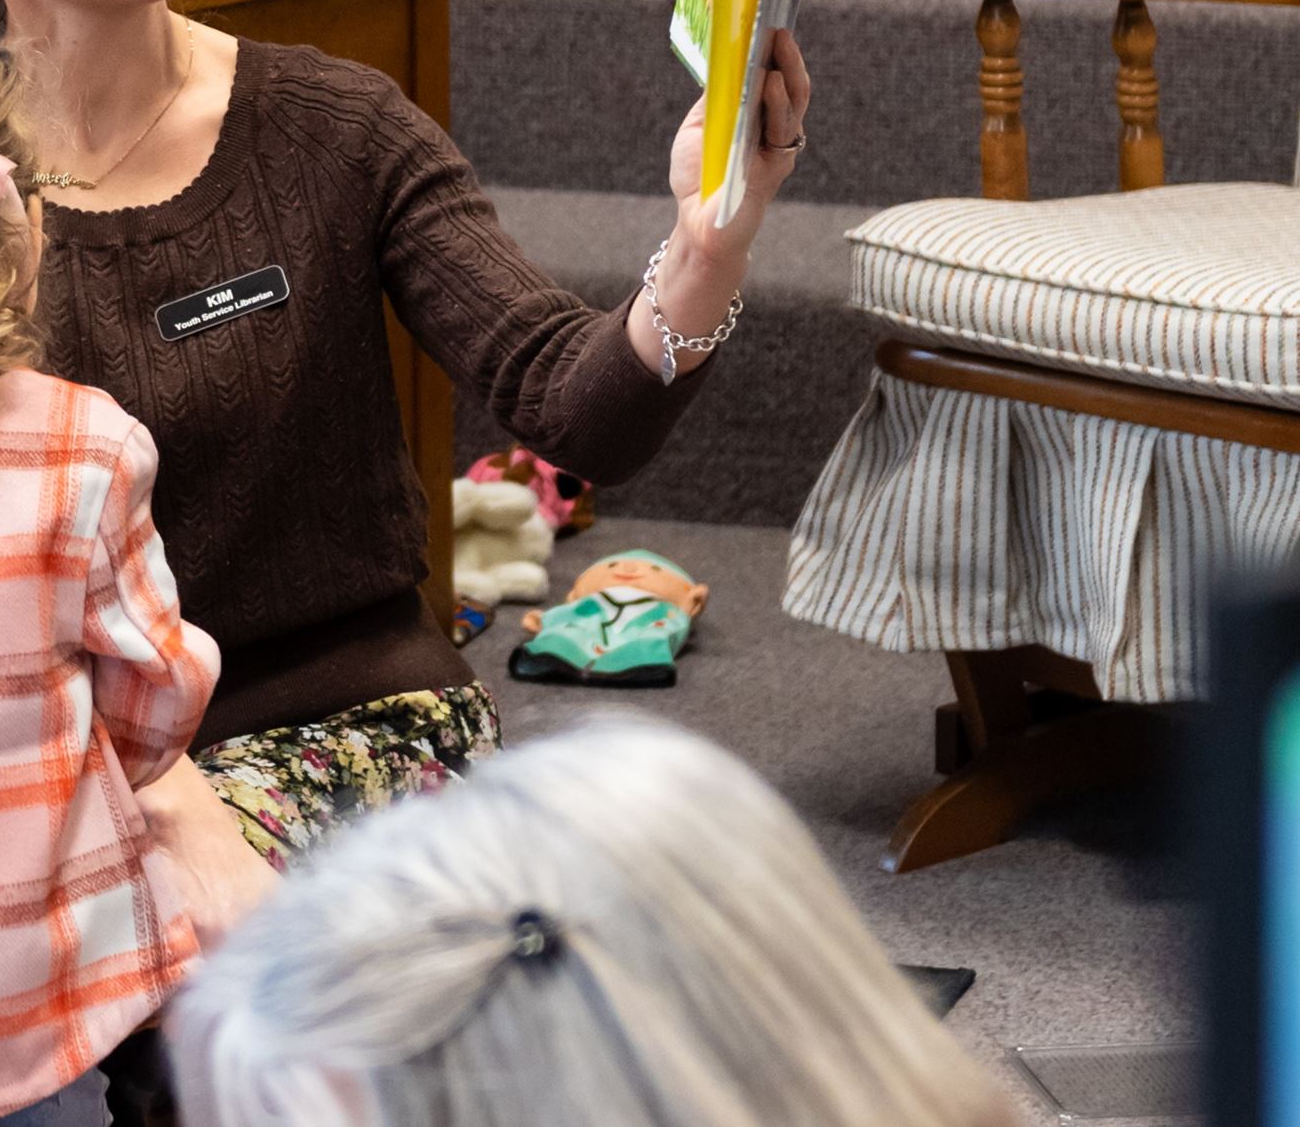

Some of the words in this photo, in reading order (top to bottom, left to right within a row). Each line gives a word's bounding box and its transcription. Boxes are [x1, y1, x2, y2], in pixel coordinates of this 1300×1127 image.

[174, 316, 202, 331] Youth
[201, 304, 234, 323] Service
[234, 290, 274, 310] Librarian
[206, 288, 234, 308] KIM
